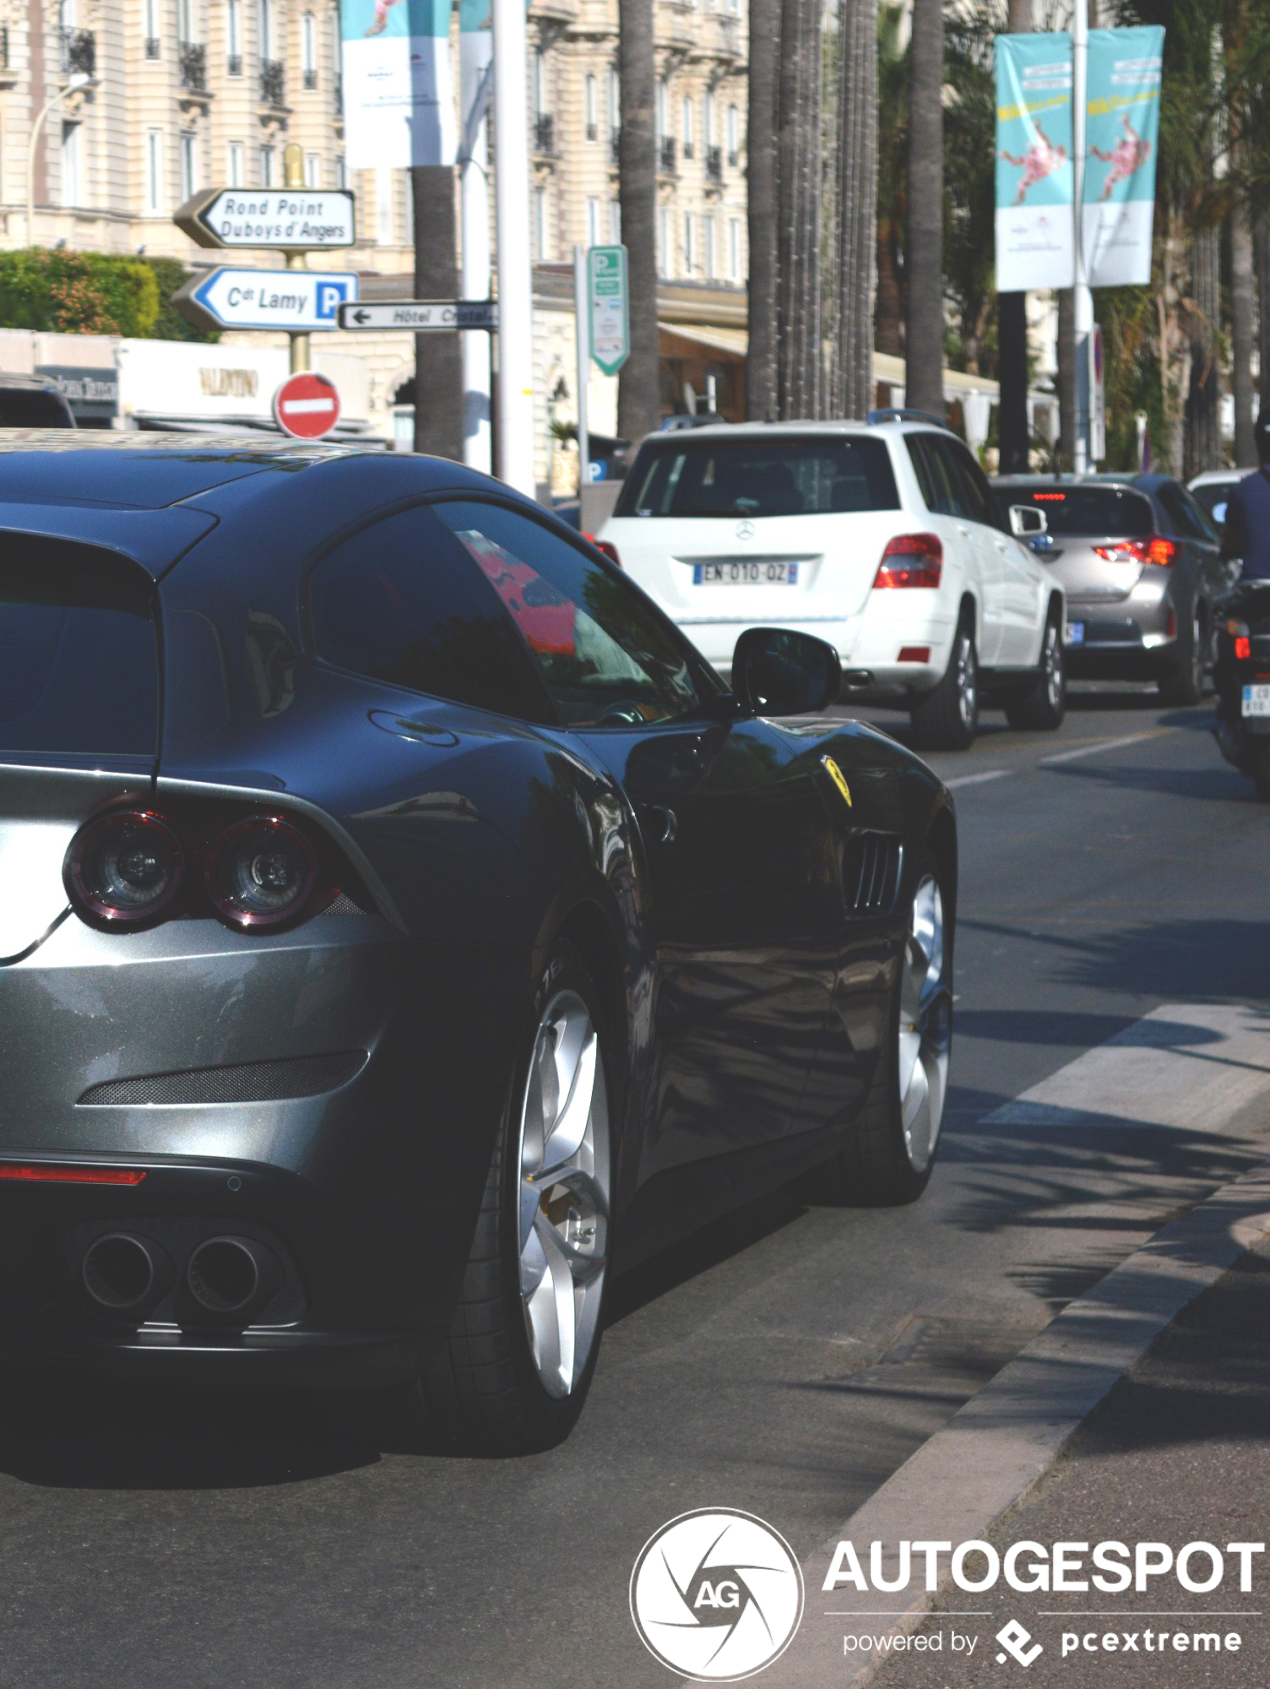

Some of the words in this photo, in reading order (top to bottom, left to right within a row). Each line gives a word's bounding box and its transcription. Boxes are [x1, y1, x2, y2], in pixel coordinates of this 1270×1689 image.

[224, 198, 268, 215] Rond
[276, 199, 322, 215] Point
[220, 221, 281, 240] Duboys
[258, 288, 307, 314] Lamy
[393, 308, 431, 322] Hôtel
